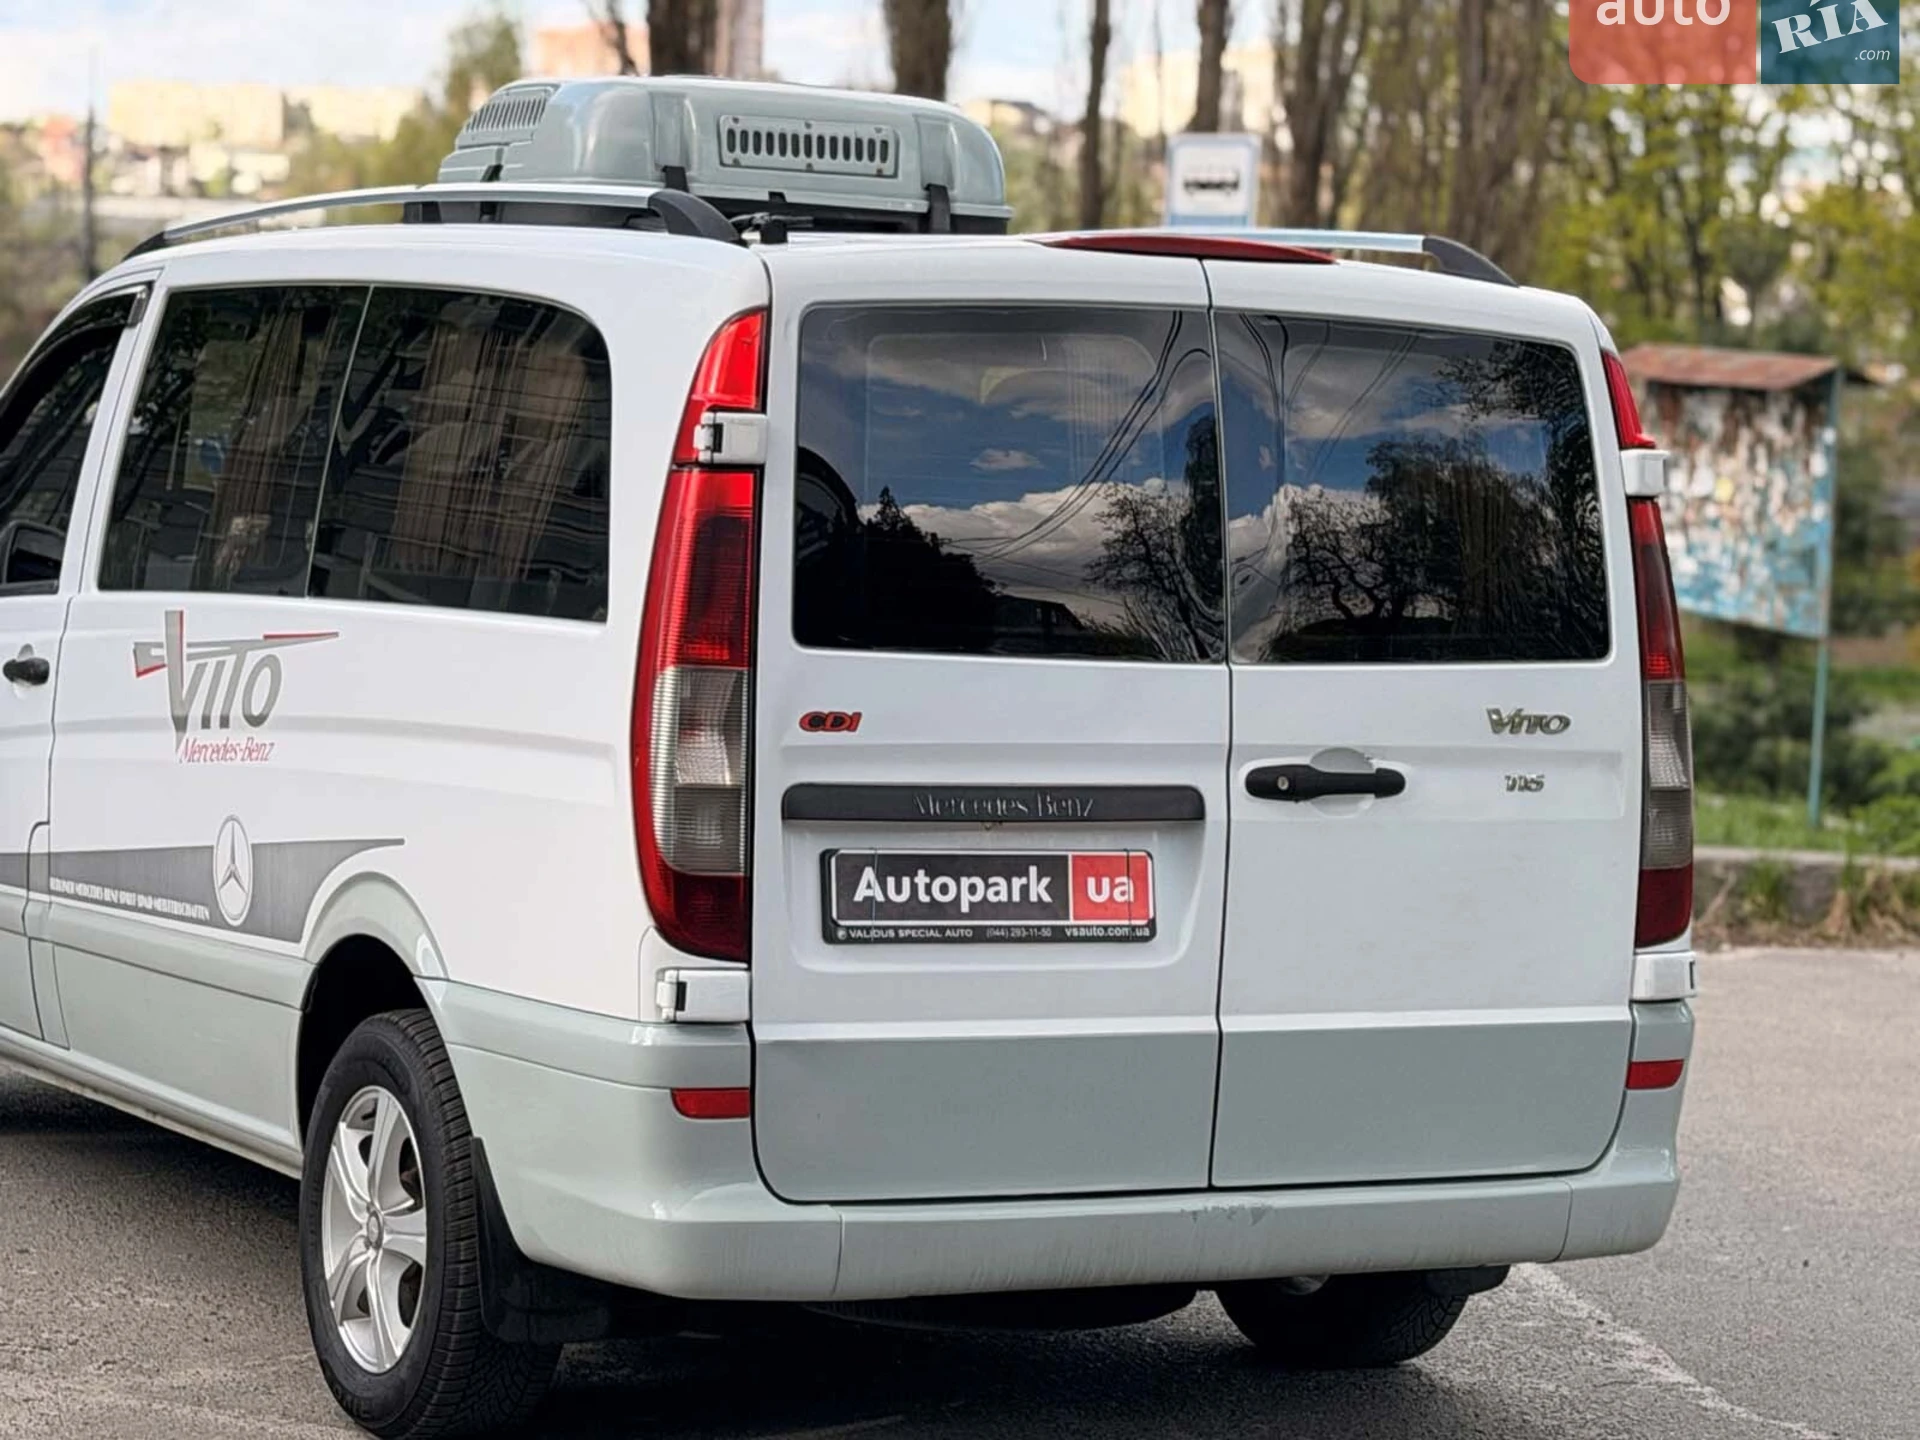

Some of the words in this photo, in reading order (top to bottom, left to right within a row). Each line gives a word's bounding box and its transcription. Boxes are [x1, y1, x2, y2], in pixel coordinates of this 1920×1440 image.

[798, 711, 862, 732] CDI
[179, 736, 275, 763] Mercedes-Benz
[853, 865, 1053, 913] Autopark
[1086, 875, 1135, 903] ua
[898, 928, 942, 938] SPECIAL
[945, 928, 973, 938] AUTO
